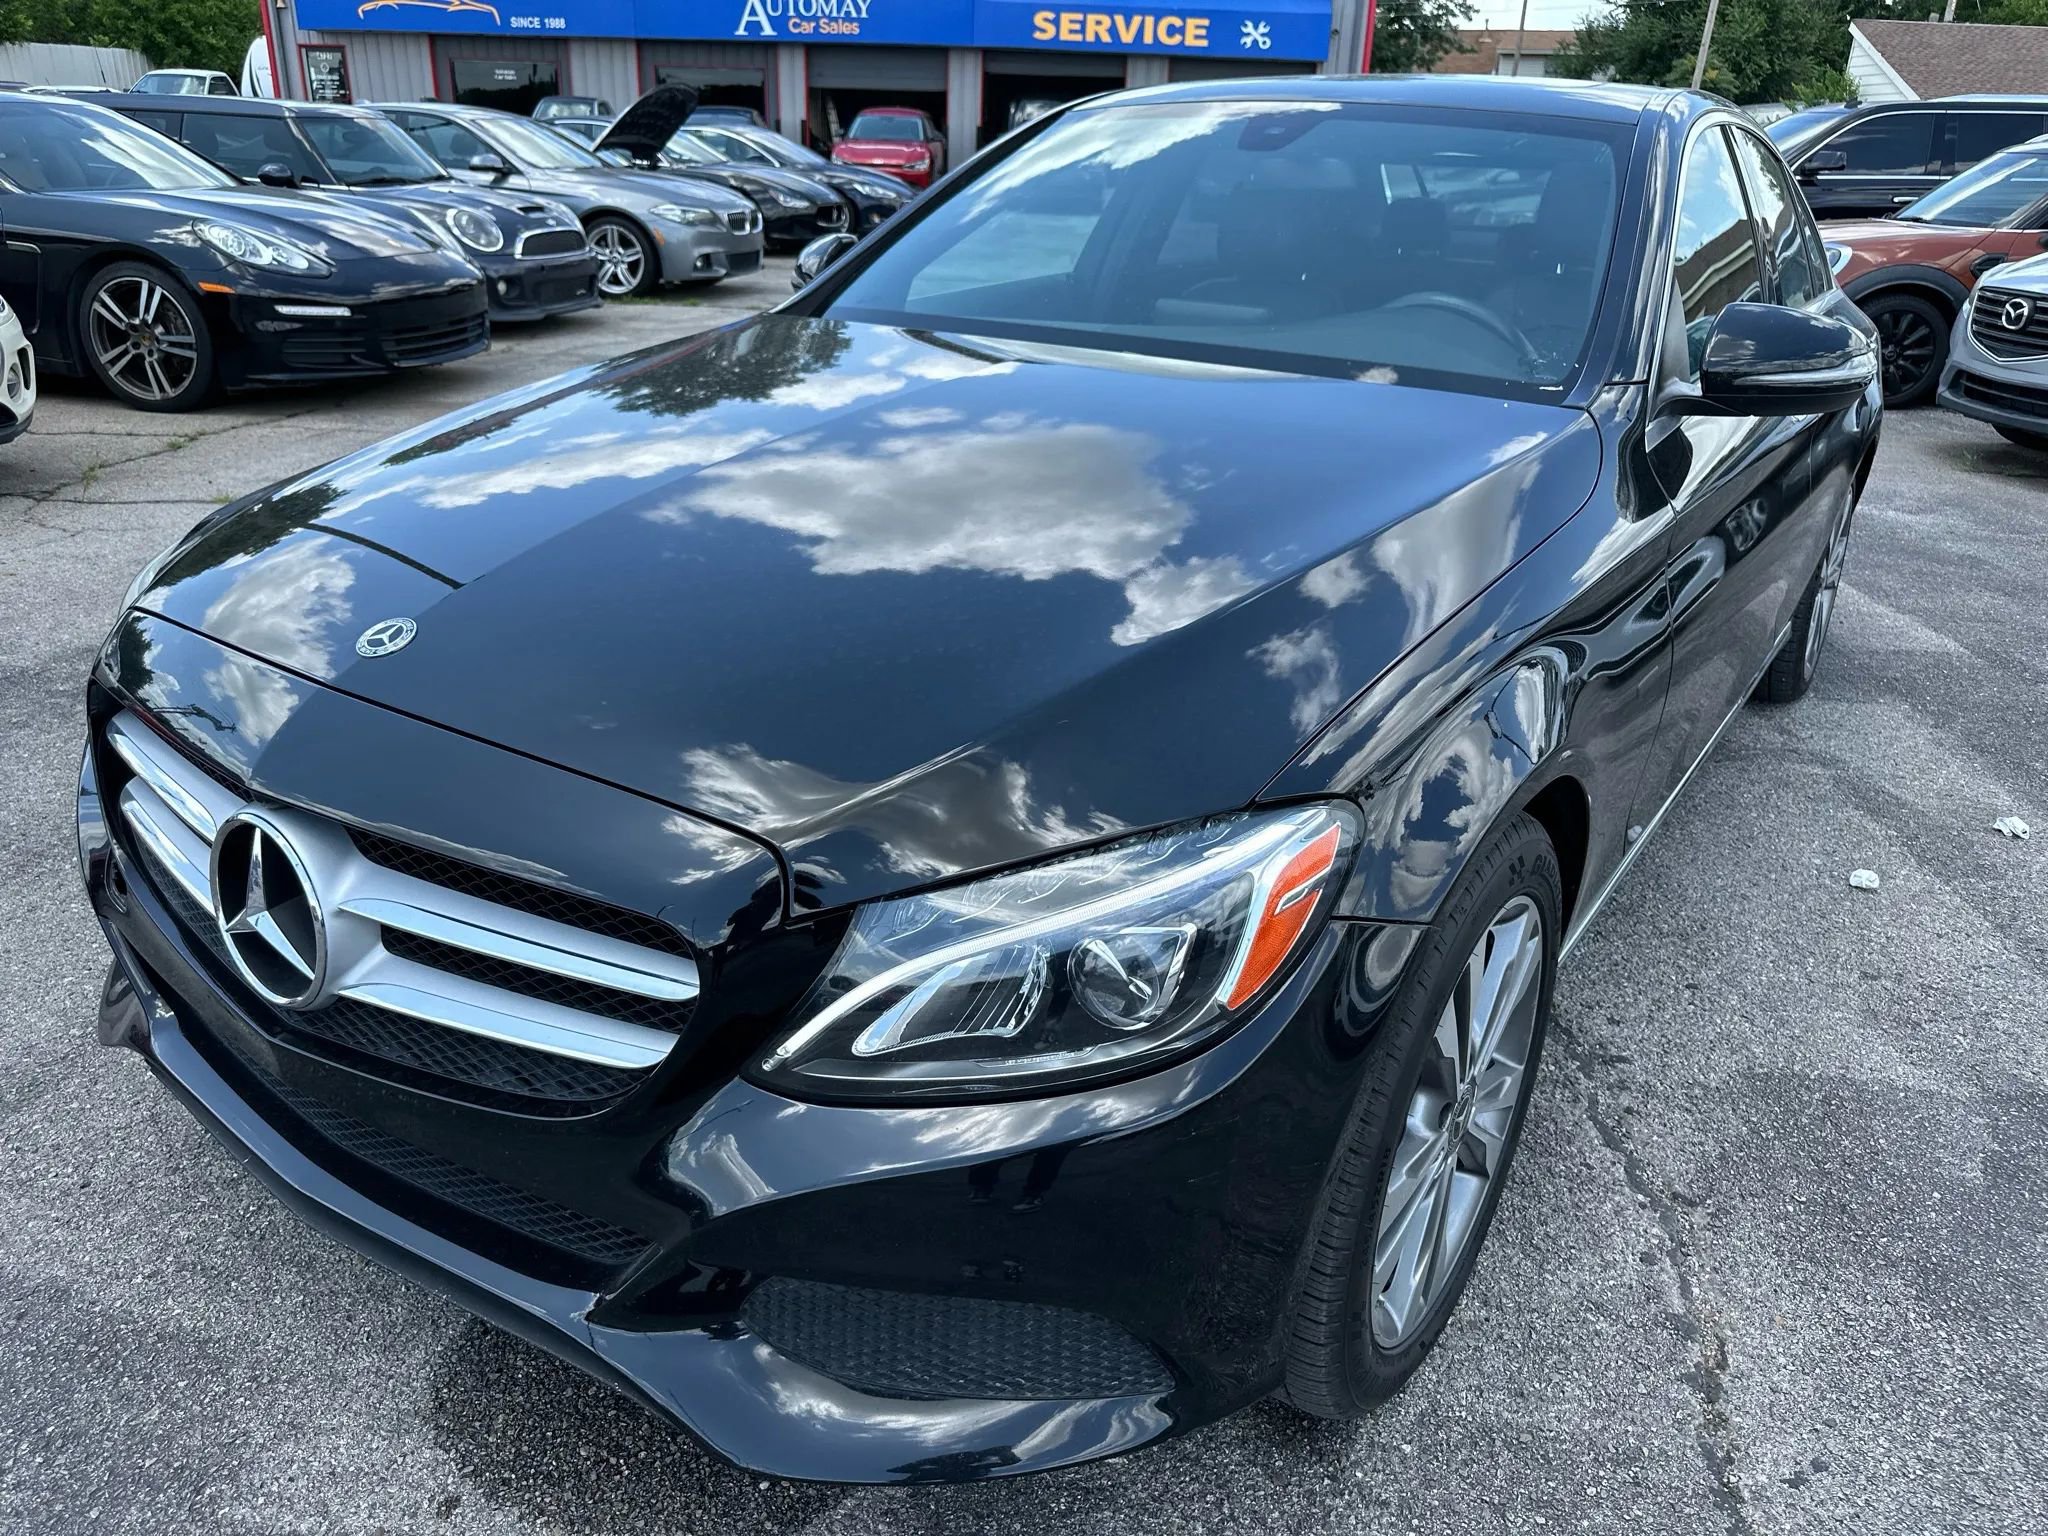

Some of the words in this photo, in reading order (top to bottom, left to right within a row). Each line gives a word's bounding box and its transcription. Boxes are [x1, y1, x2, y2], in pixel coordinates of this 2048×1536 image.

[510, 16, 541, 29] SINCE
[734, 0, 871, 36] AUTOMAY
[788, 18, 816, 34] Car
[819, 18, 860, 35] Sales
[1032, 11, 1210, 47] SERVICE
